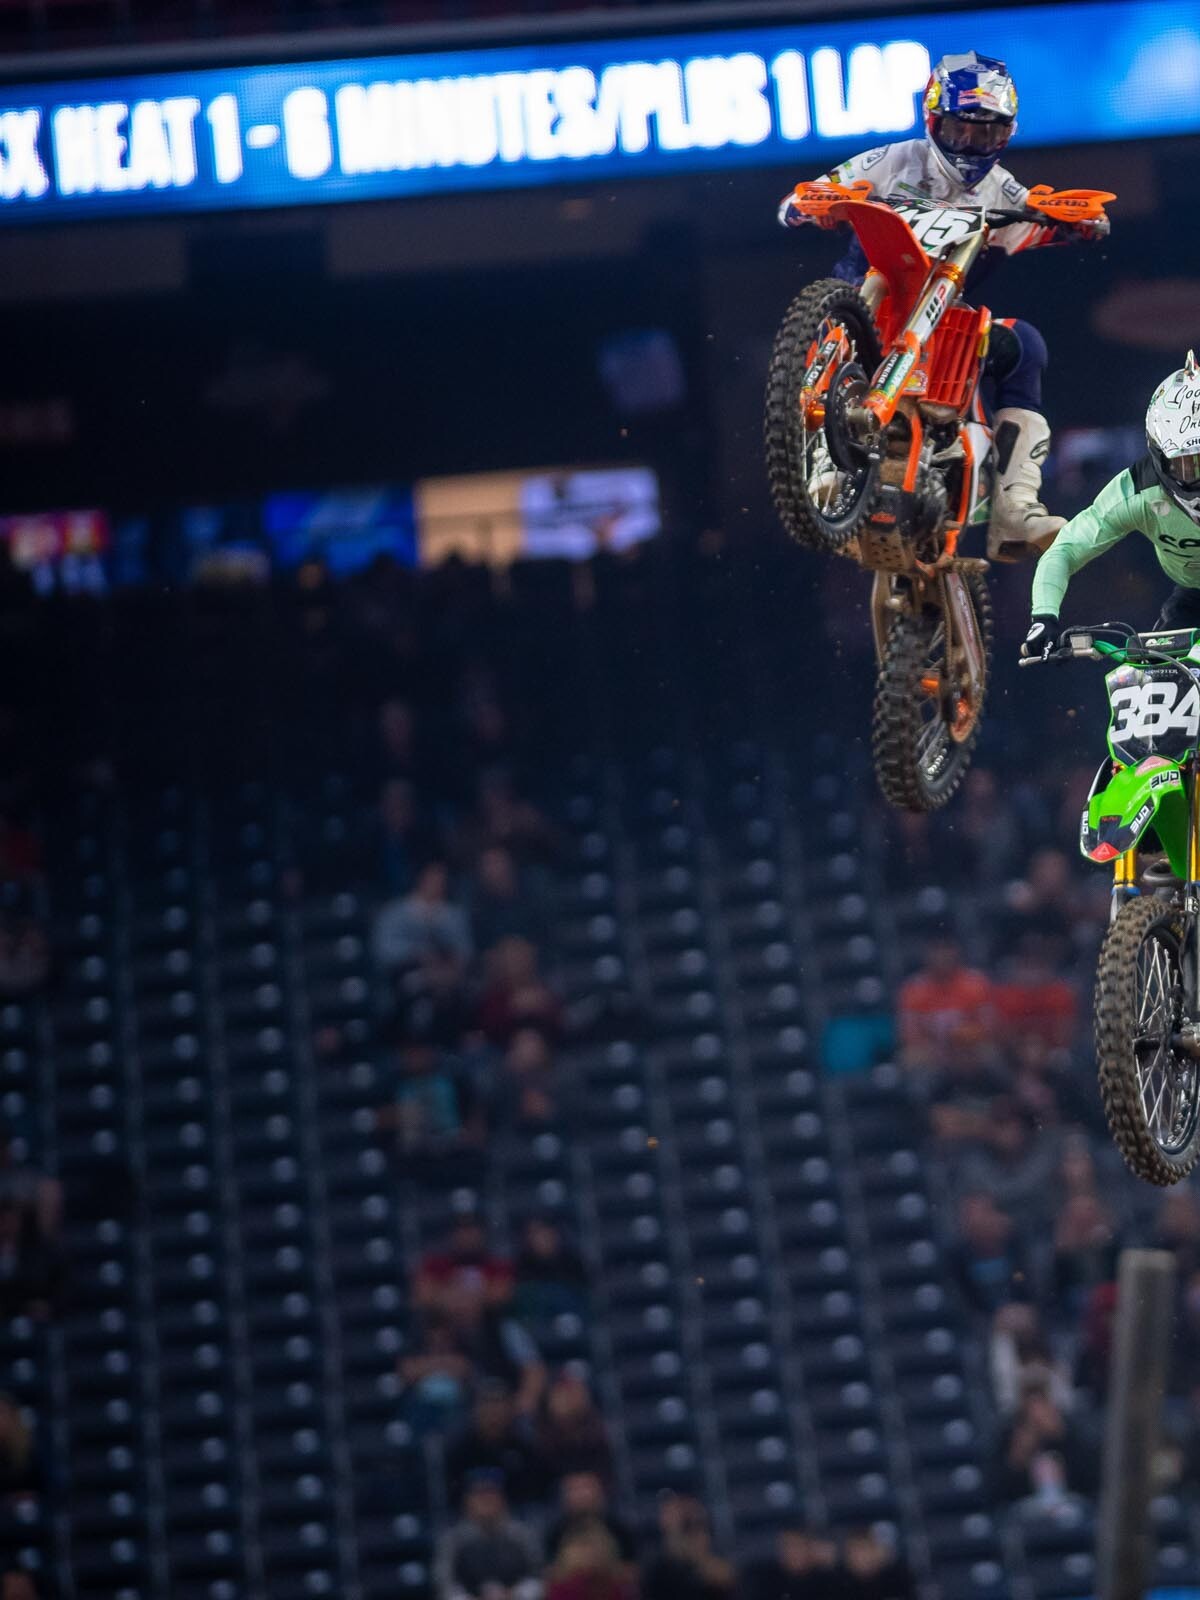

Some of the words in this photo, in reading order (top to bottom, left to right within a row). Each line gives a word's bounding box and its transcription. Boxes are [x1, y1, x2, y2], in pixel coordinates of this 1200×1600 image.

[53, 96, 201, 195] HEAT
[206, 92, 244, 184] 1
[283, 86, 333, 180] 6
[771, 48, 811, 141] 1
[811, 39, 932, 138] LAP
